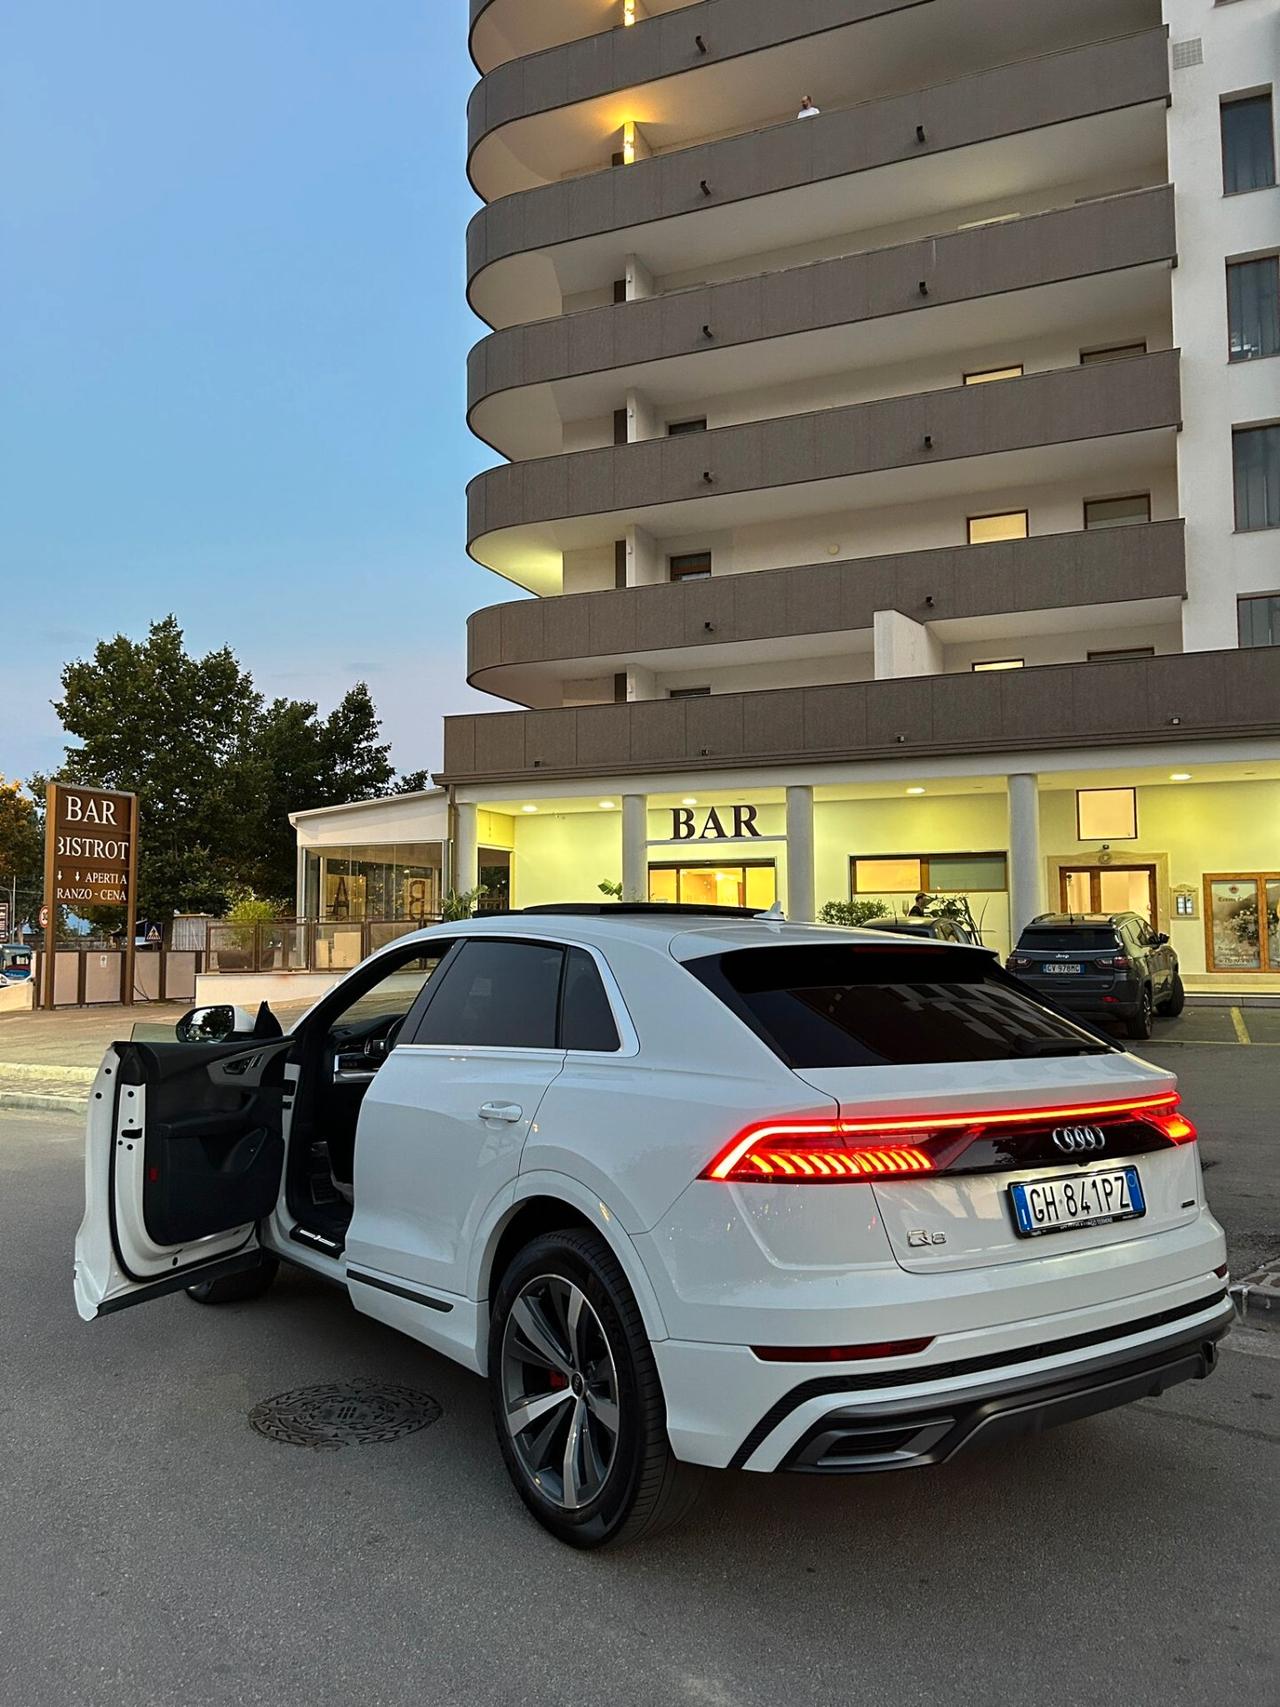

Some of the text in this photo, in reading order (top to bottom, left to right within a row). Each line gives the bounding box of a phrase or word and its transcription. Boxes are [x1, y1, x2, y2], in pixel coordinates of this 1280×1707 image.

[65, 795, 118, 826] BAR
[669, 805, 762, 840] BAR
[85, 872, 127, 885] APERTI A
[57, 887, 92, 900] RANZO
[100, 889, 127, 901] CENA
[1030, 1175, 1130, 1223] GH 841PZ
[907, 1229, 947, 1247] Q8
